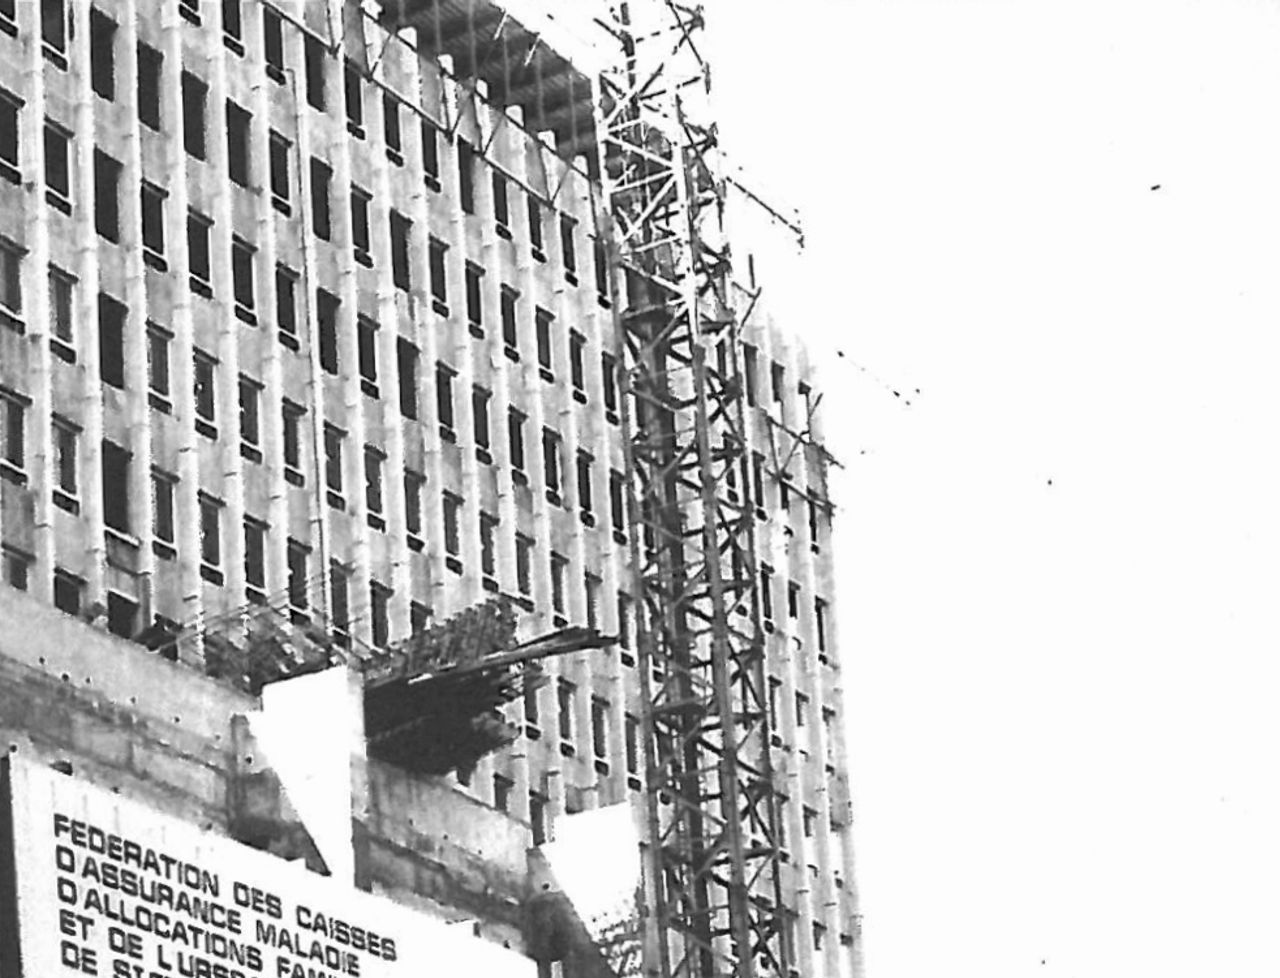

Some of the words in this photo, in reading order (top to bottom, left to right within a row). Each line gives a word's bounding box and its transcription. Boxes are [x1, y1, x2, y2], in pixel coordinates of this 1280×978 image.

[54, 813, 219, 897] FEDERATION
[233, 881, 283, 919] DES
[296, 904, 397, 962] CAISSES
[59, 908, 95, 941] ET
[108, 926, 144, 960] DE
[61, 939, 98, 976] DE
[255, 919, 360, 978] MALADIE
